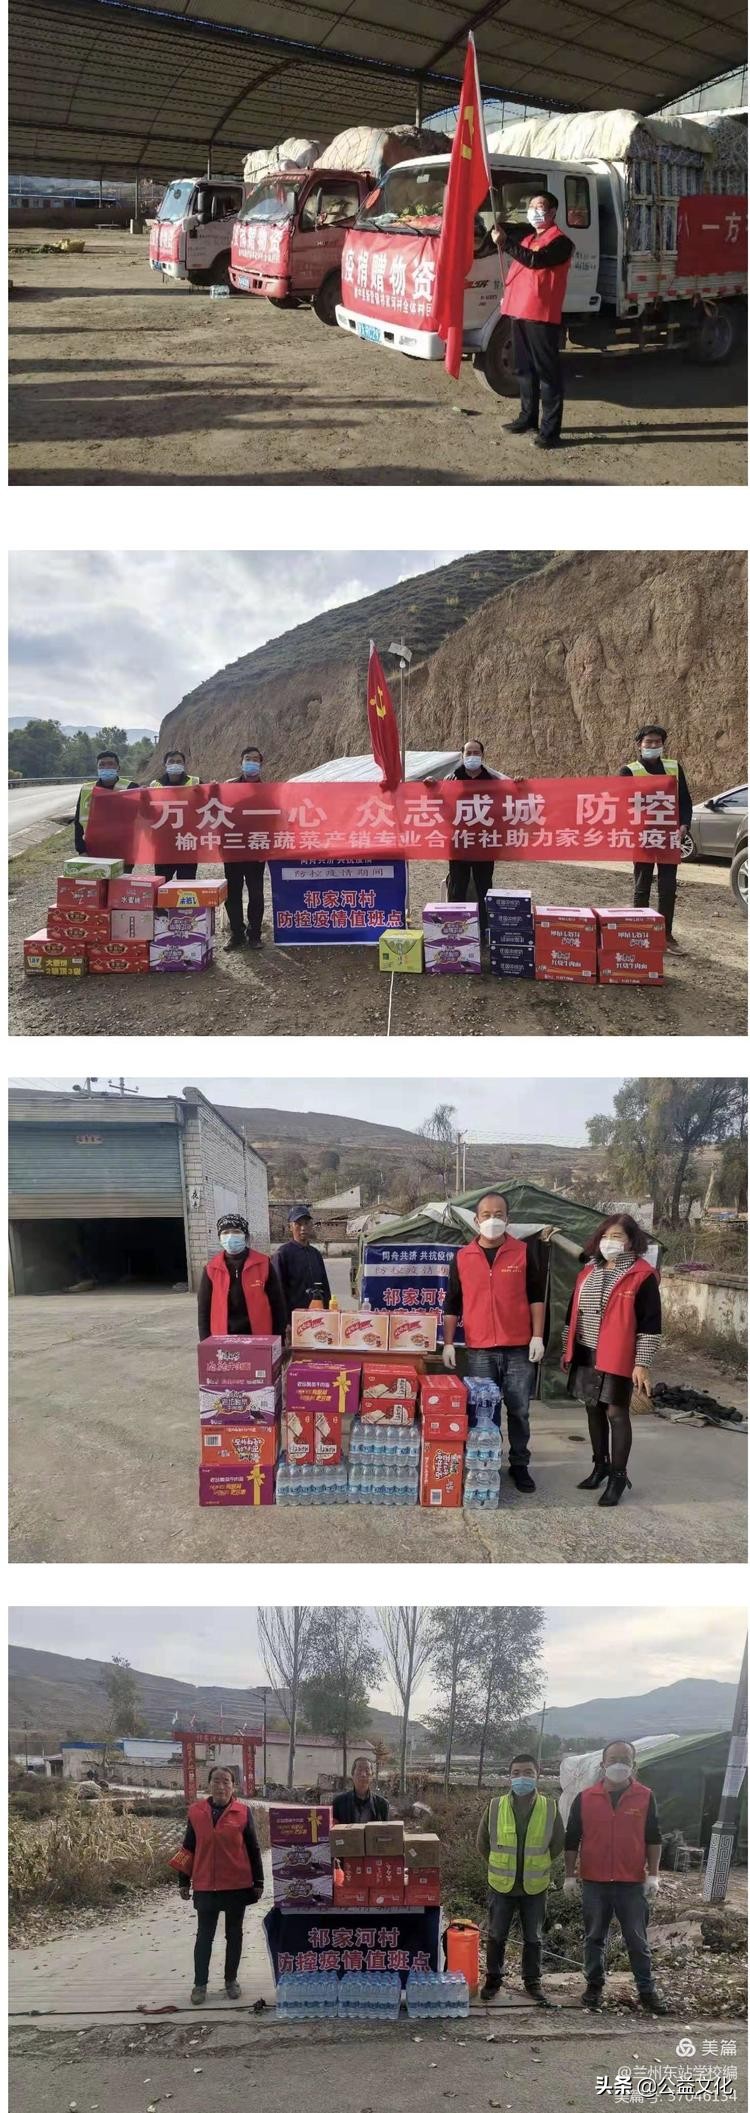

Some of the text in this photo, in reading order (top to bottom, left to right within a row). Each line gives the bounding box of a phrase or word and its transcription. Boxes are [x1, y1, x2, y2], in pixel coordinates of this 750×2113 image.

[702, 210, 748, 243] 一方
[151, 790, 678, 830] 万众一心 众志成城 防控
[303, 889, 377, 908] 祁家河村
[277, 909, 403, 928] 防控疫情值班点
[382, 1250, 418, 1261] 同舟共济
[308, 1927, 400, 1948] 祁家河村
[277, 1949, 432, 1973] 防控疫情值班点
